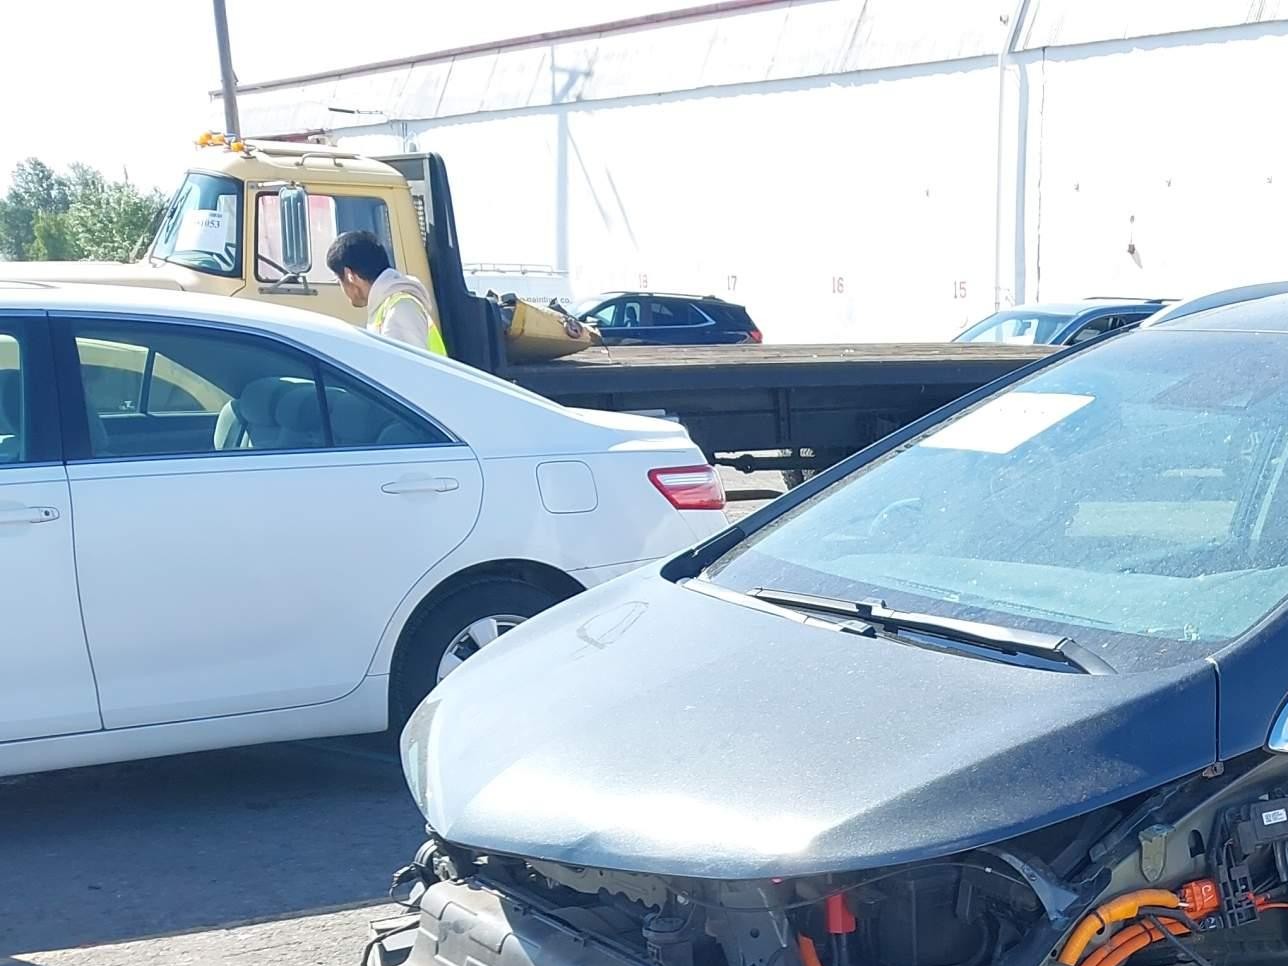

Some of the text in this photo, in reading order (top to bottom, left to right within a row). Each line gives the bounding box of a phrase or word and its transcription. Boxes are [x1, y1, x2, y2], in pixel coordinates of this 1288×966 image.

[727, 275, 737, 290] 17
[832, 276, 844, 294] 16
[953, 279, 967, 299] 15
